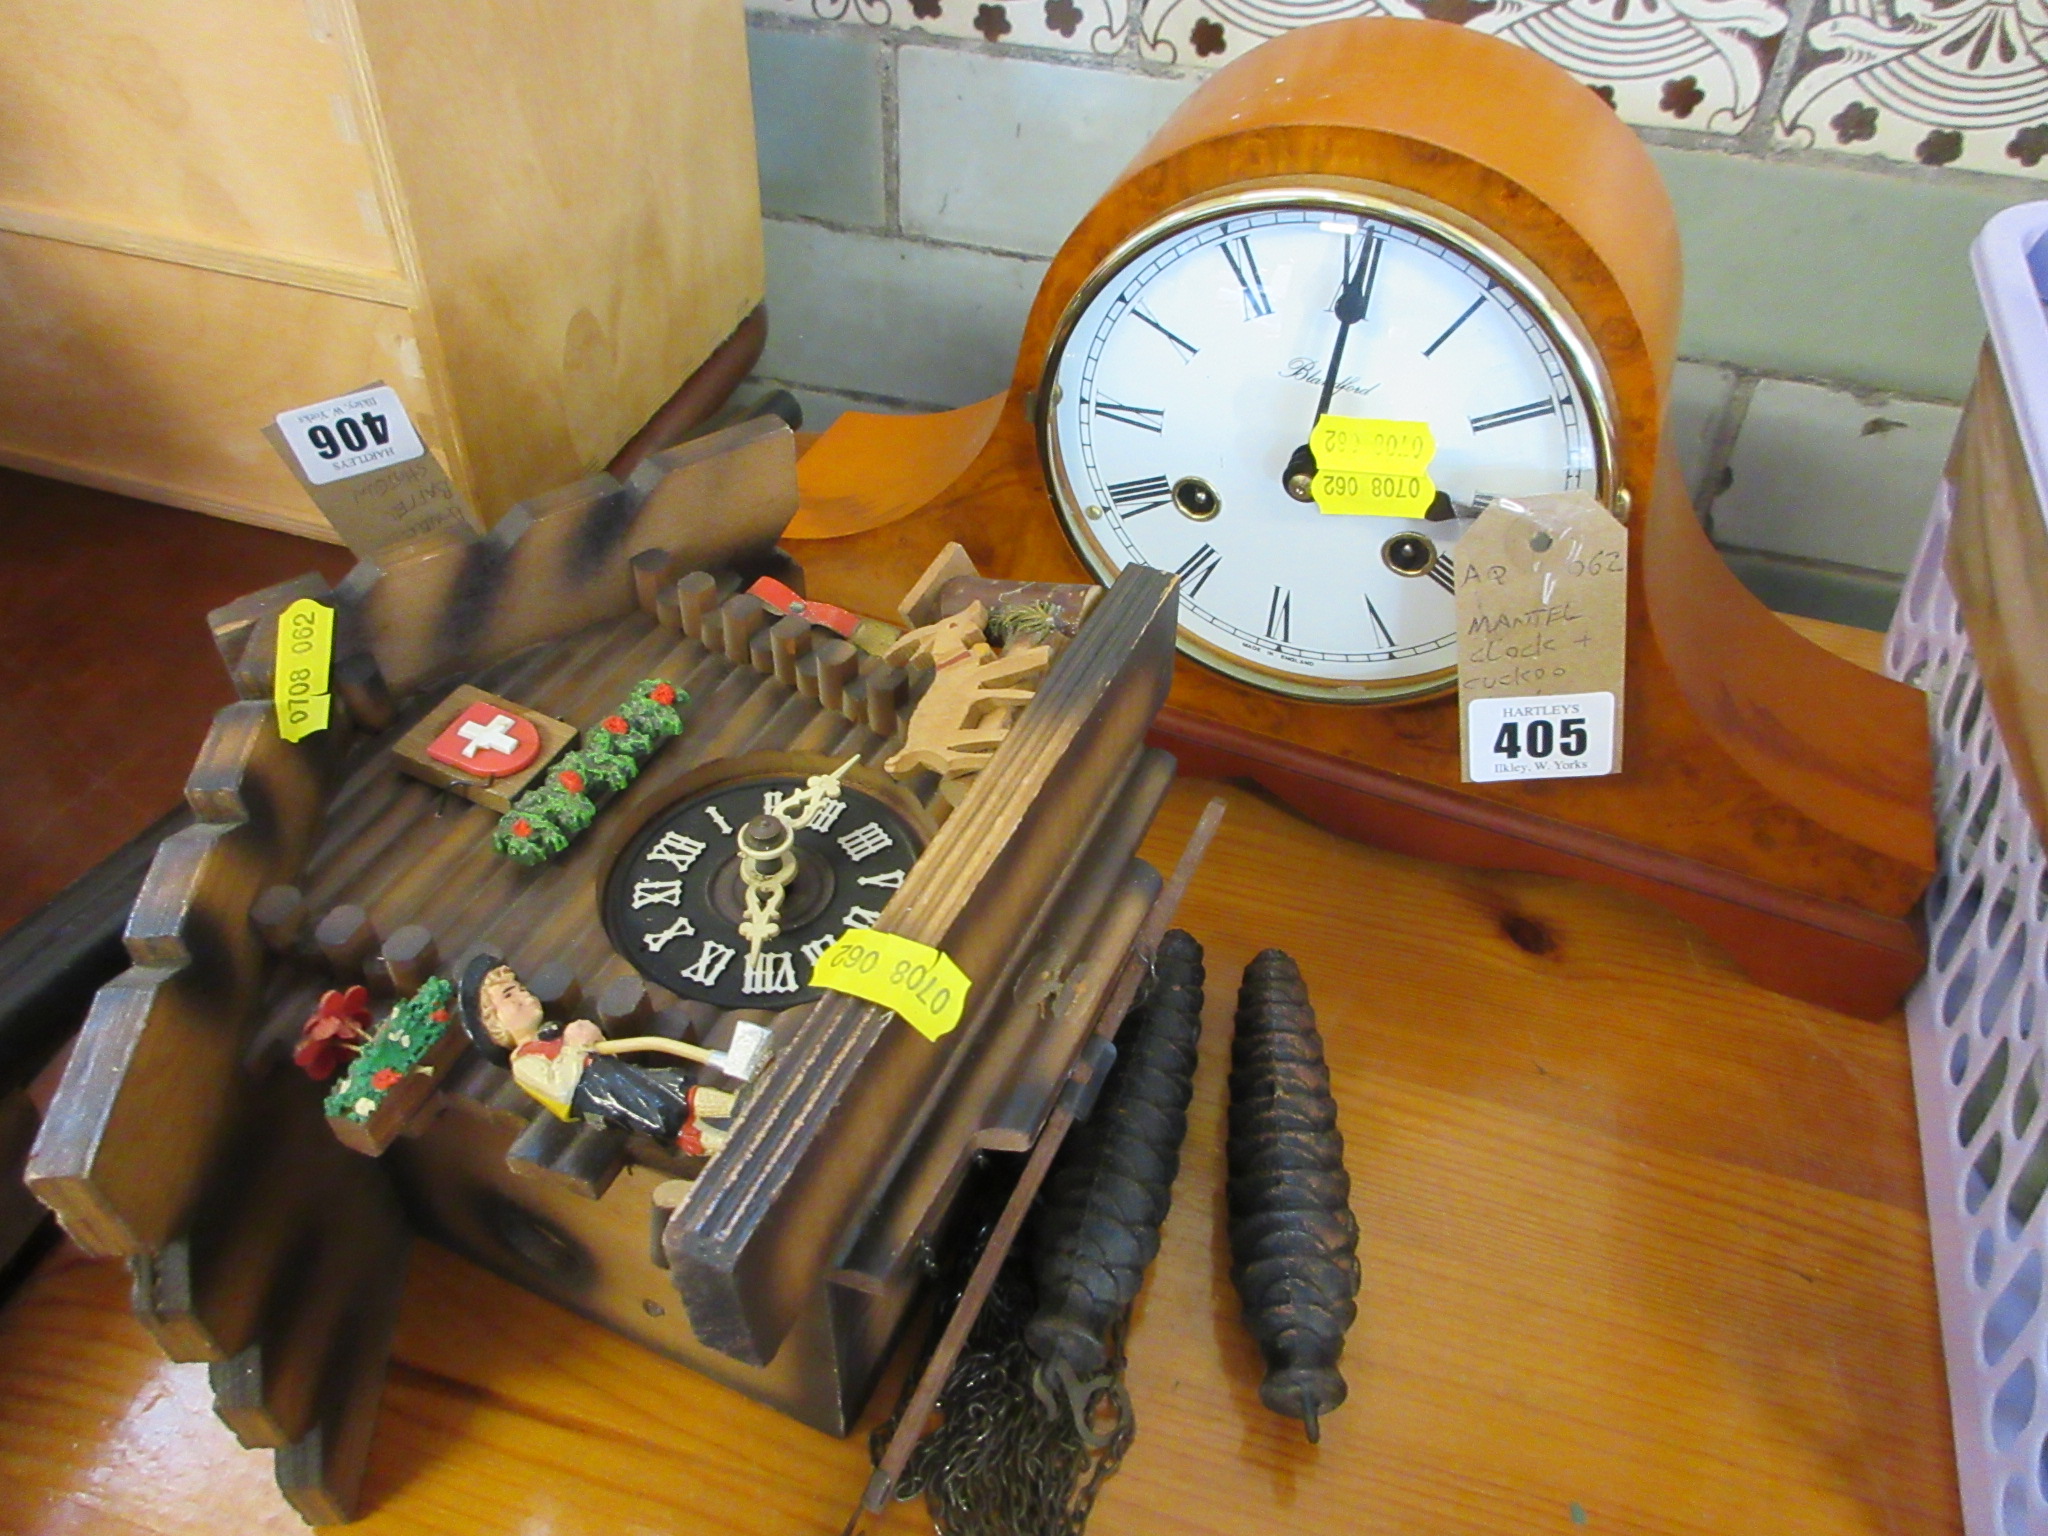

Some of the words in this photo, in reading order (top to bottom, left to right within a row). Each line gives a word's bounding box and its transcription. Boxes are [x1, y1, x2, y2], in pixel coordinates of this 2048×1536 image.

[1278, 357, 1381, 396] Bladford
[307, 411, 390, 460] 406
[333, 446, 396, 471] HARTLEYS
[1323, 475, 1358, 496] 062
[1371, 477, 1420, 498] 0708
[291, 611, 315, 654] 062
[1242, 642, 1261, 652] MADE
[1280, 654, 1314, 667] ENGLAND
[288, 668, 311, 724] 0708
[1502, 704, 1581, 718] HARTLEYS
[1493, 717, 1589, 759] 405
[1554, 760, 1588, 771] Yorks
[830, 944, 879, 974] 062
[889, 959, 951, 1016] 0708
